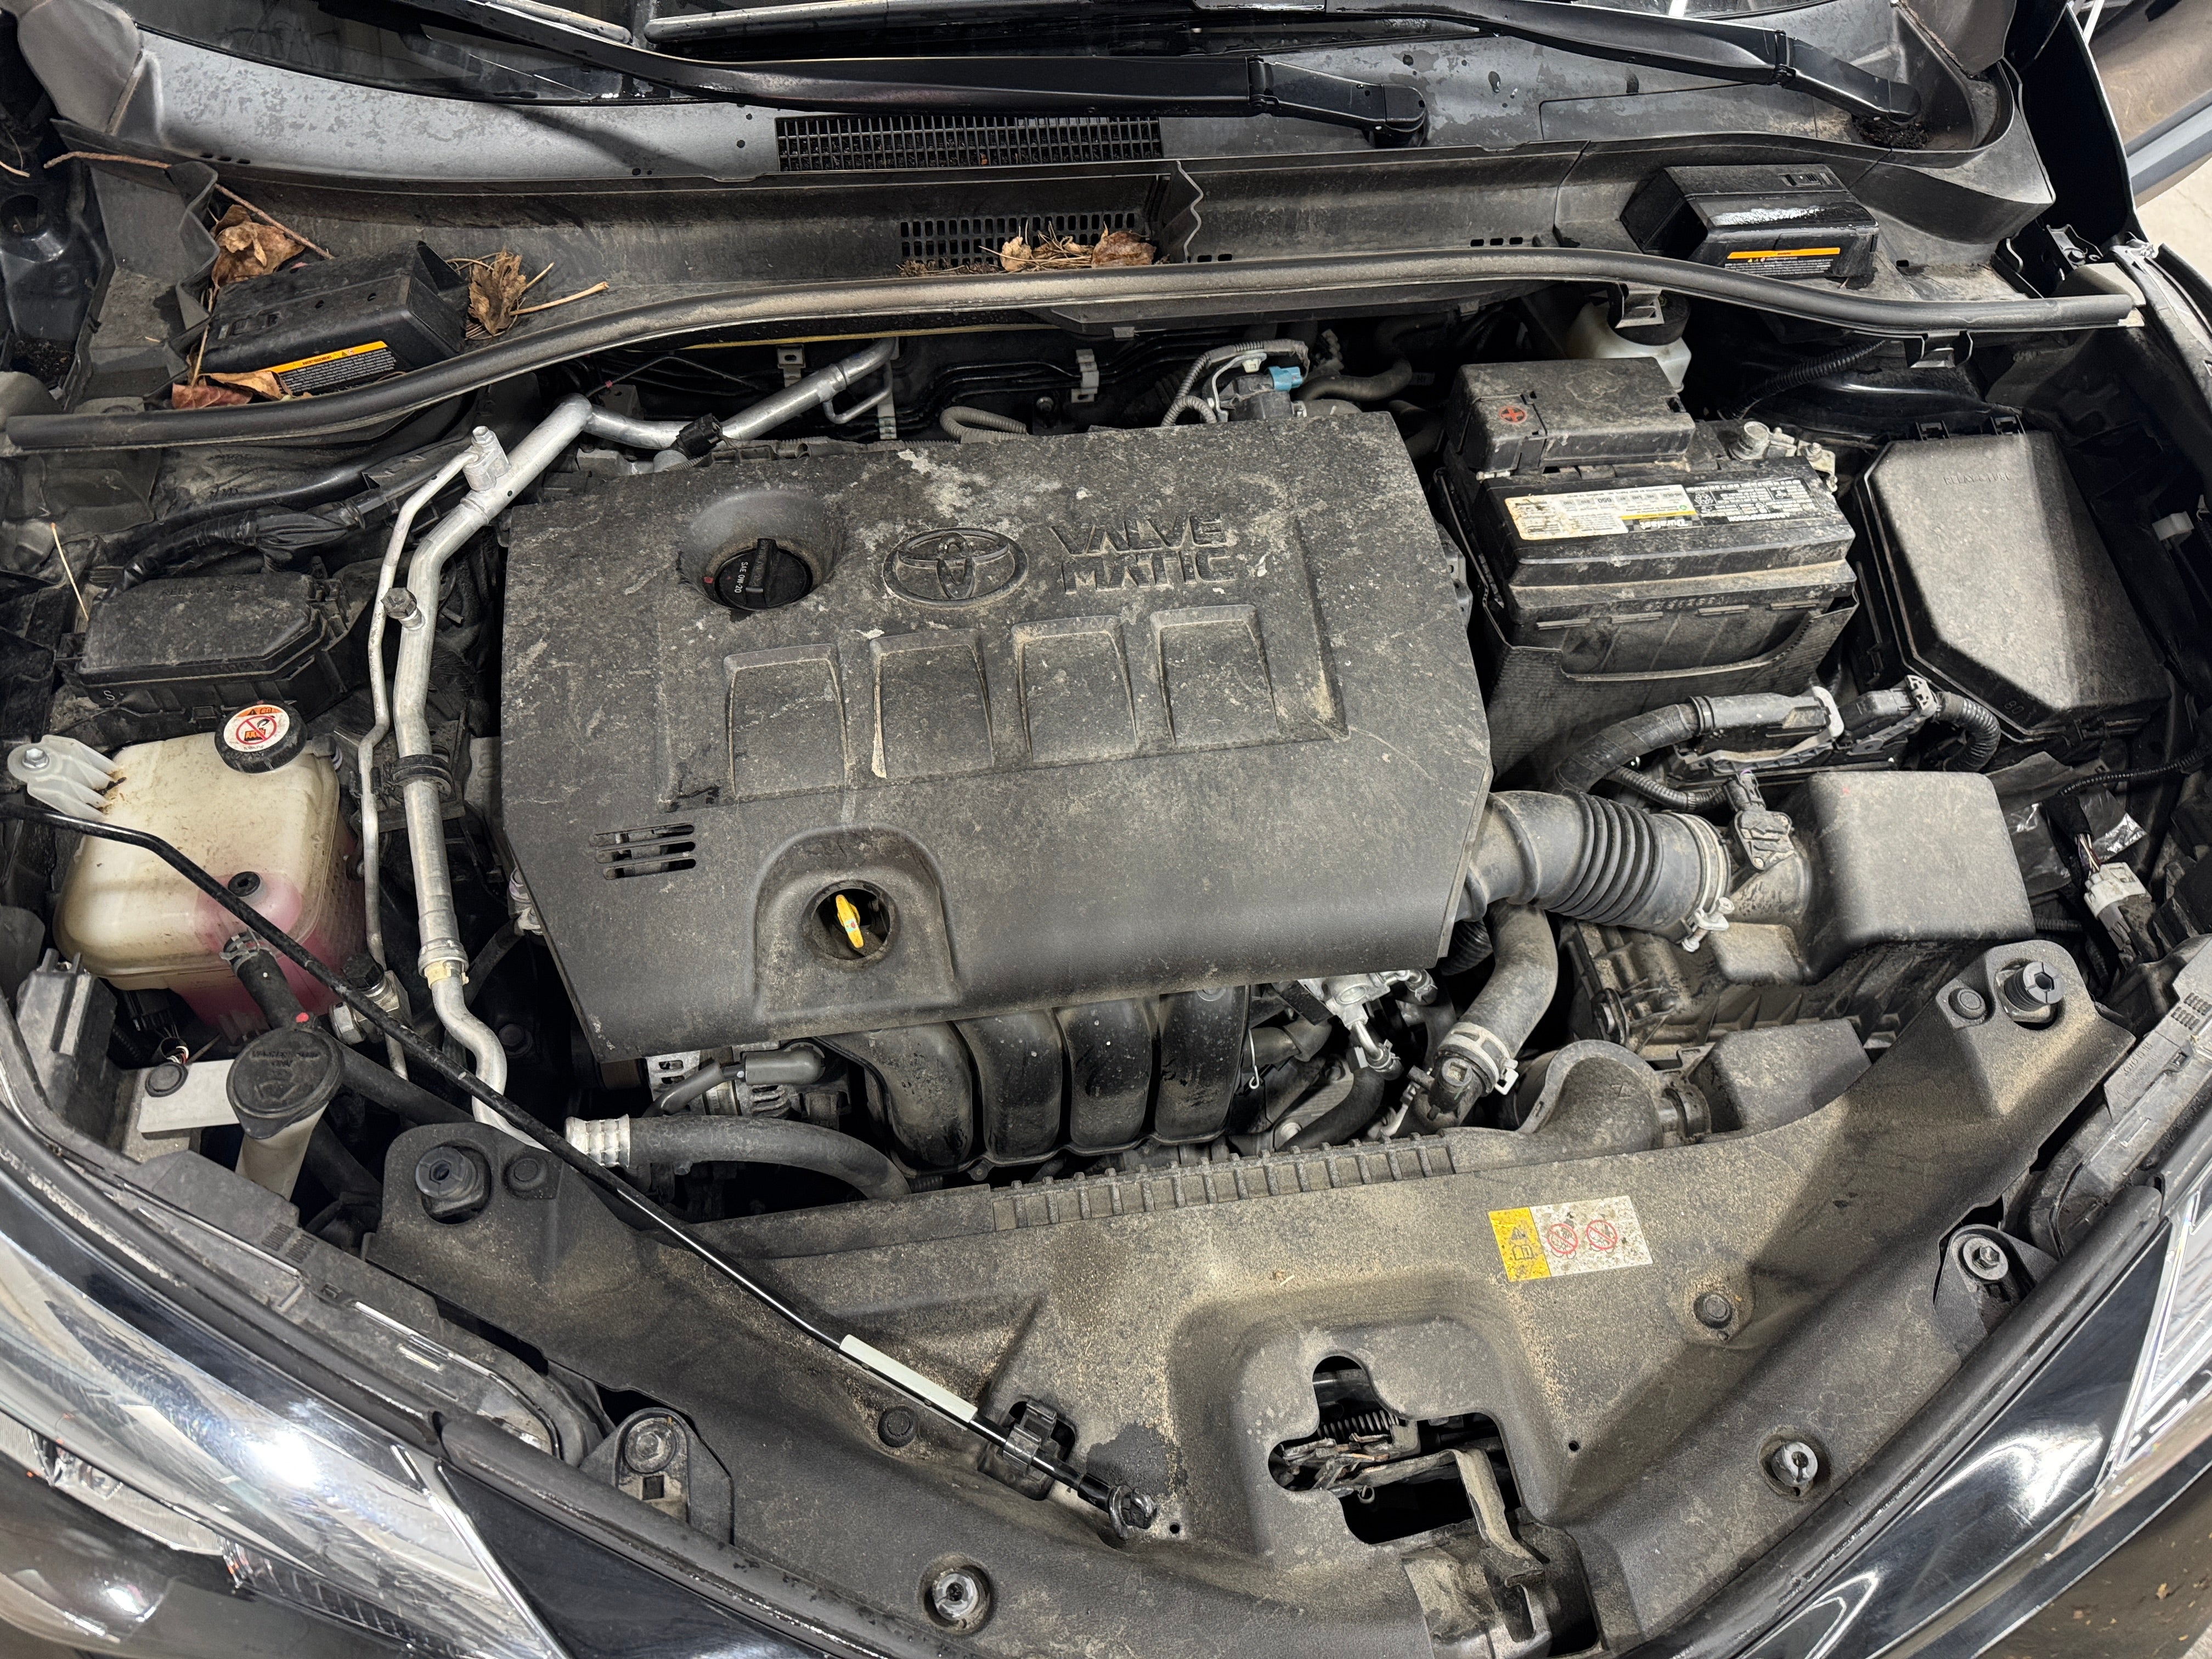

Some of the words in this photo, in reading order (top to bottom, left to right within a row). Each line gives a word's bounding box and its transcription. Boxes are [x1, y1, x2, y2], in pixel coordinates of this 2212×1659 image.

[1639, 518, 1689, 531] Duralast
[1049, 513, 1228, 556] VALVE
[739, 561, 749, 573] SAE
[1060, 546, 1238, 595] MATIC
[734, 574, 746, 593] 0W-20
